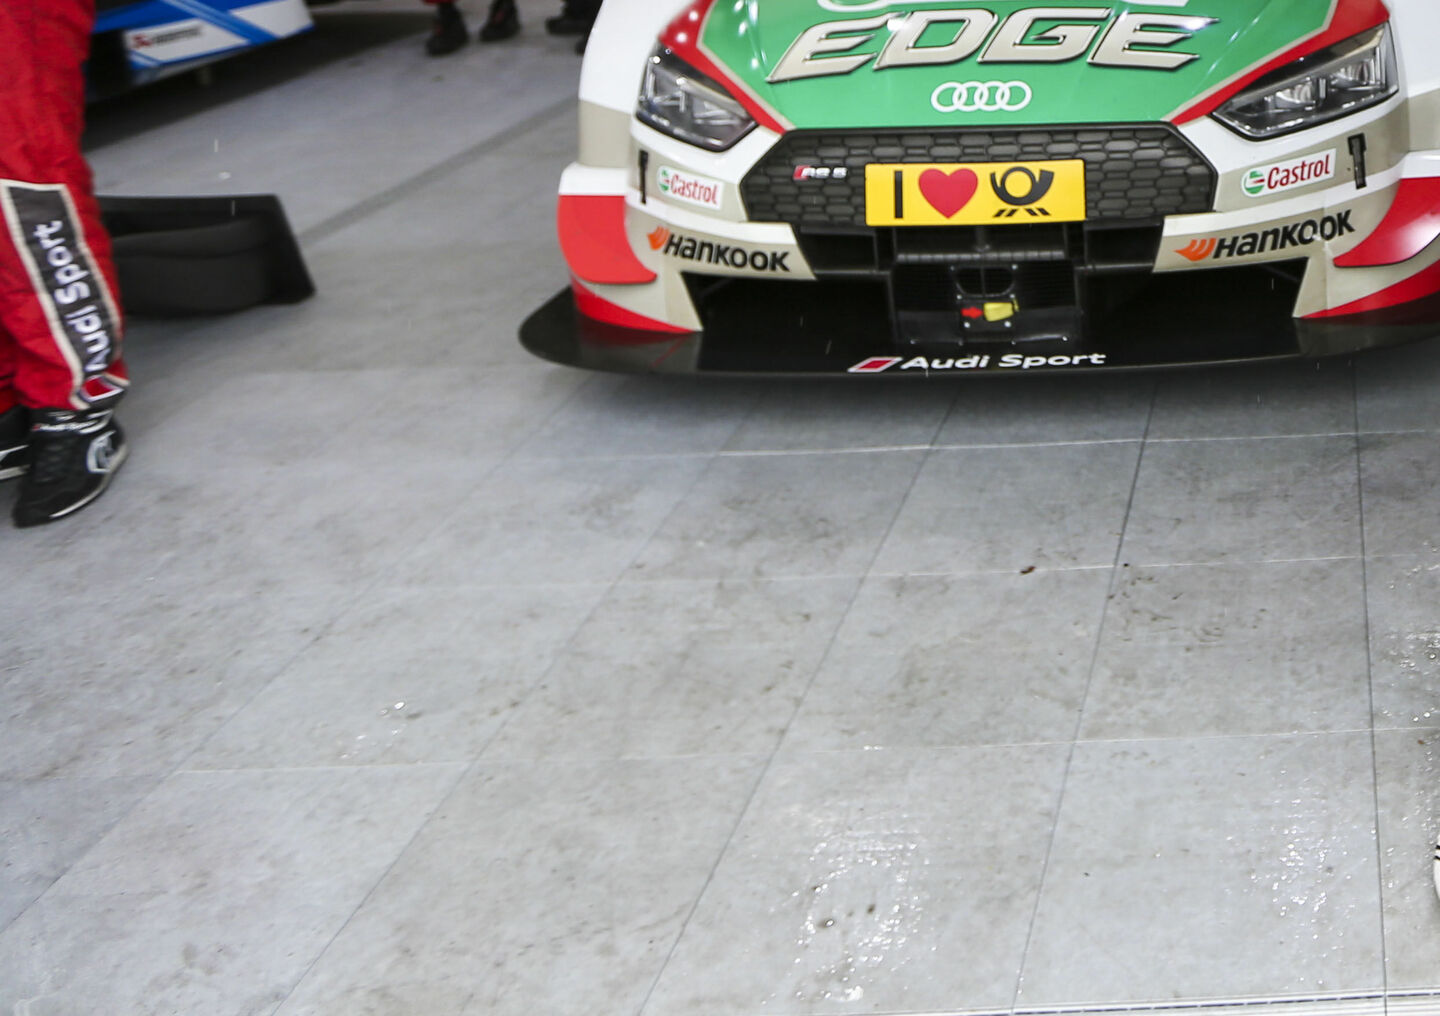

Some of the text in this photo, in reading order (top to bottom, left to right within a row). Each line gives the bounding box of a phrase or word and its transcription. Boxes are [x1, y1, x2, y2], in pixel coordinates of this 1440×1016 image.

[766, 6, 1220, 84] EDGE
[669, 170, 720, 205] Castrol
[1265, 153, 1331, 191] Castrol
[894, 169, 904, 220] I
[33, 219, 92, 305] Sport
[901, 352, 1107, 371] Audi Sport
